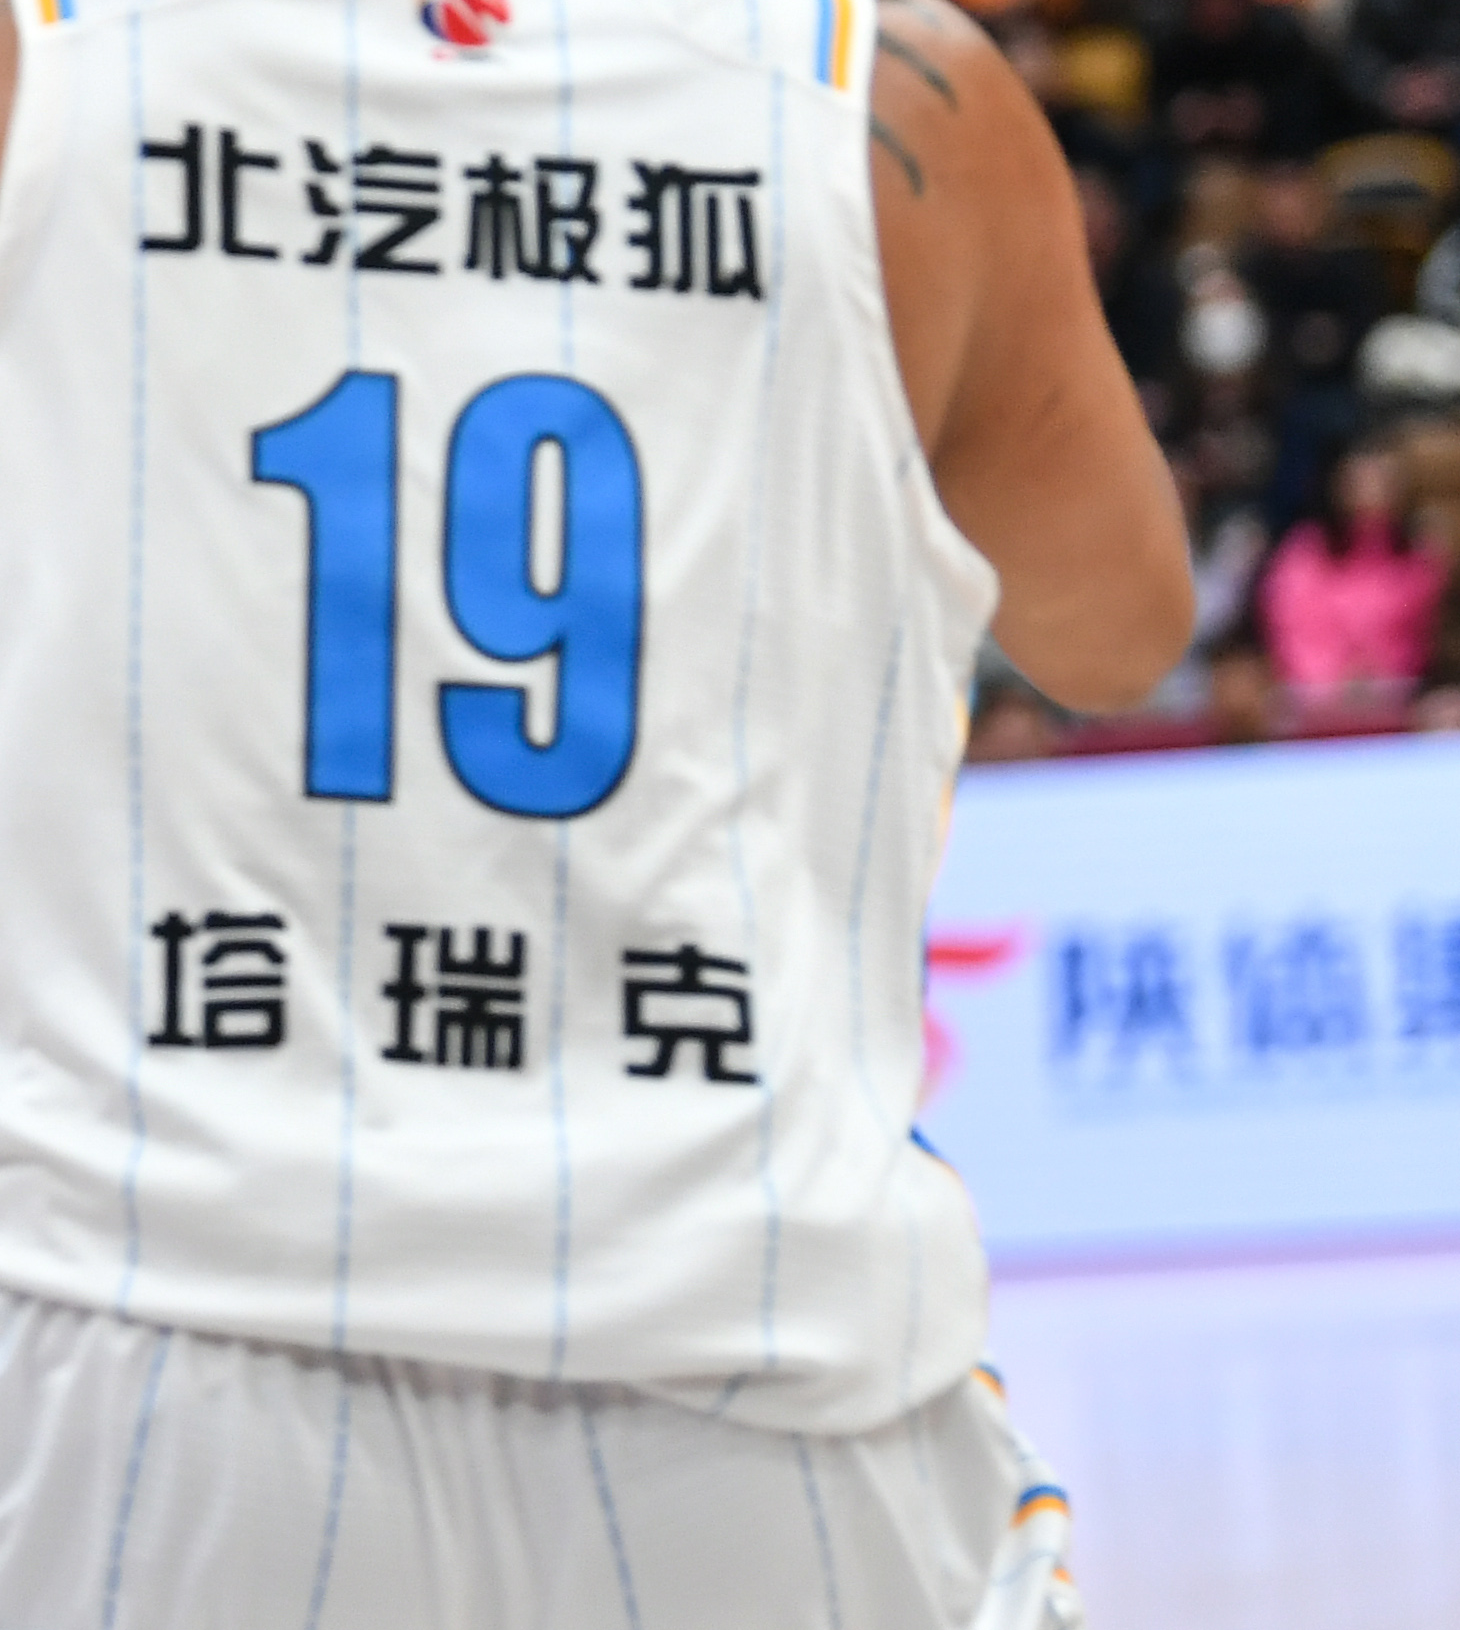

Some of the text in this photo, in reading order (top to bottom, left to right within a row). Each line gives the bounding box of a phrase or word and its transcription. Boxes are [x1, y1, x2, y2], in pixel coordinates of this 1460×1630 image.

[138, 121, 766, 303] 北汽极狐
[248, 367, 646, 822] 19
[147, 909, 763, 1087] 塔瑞克
